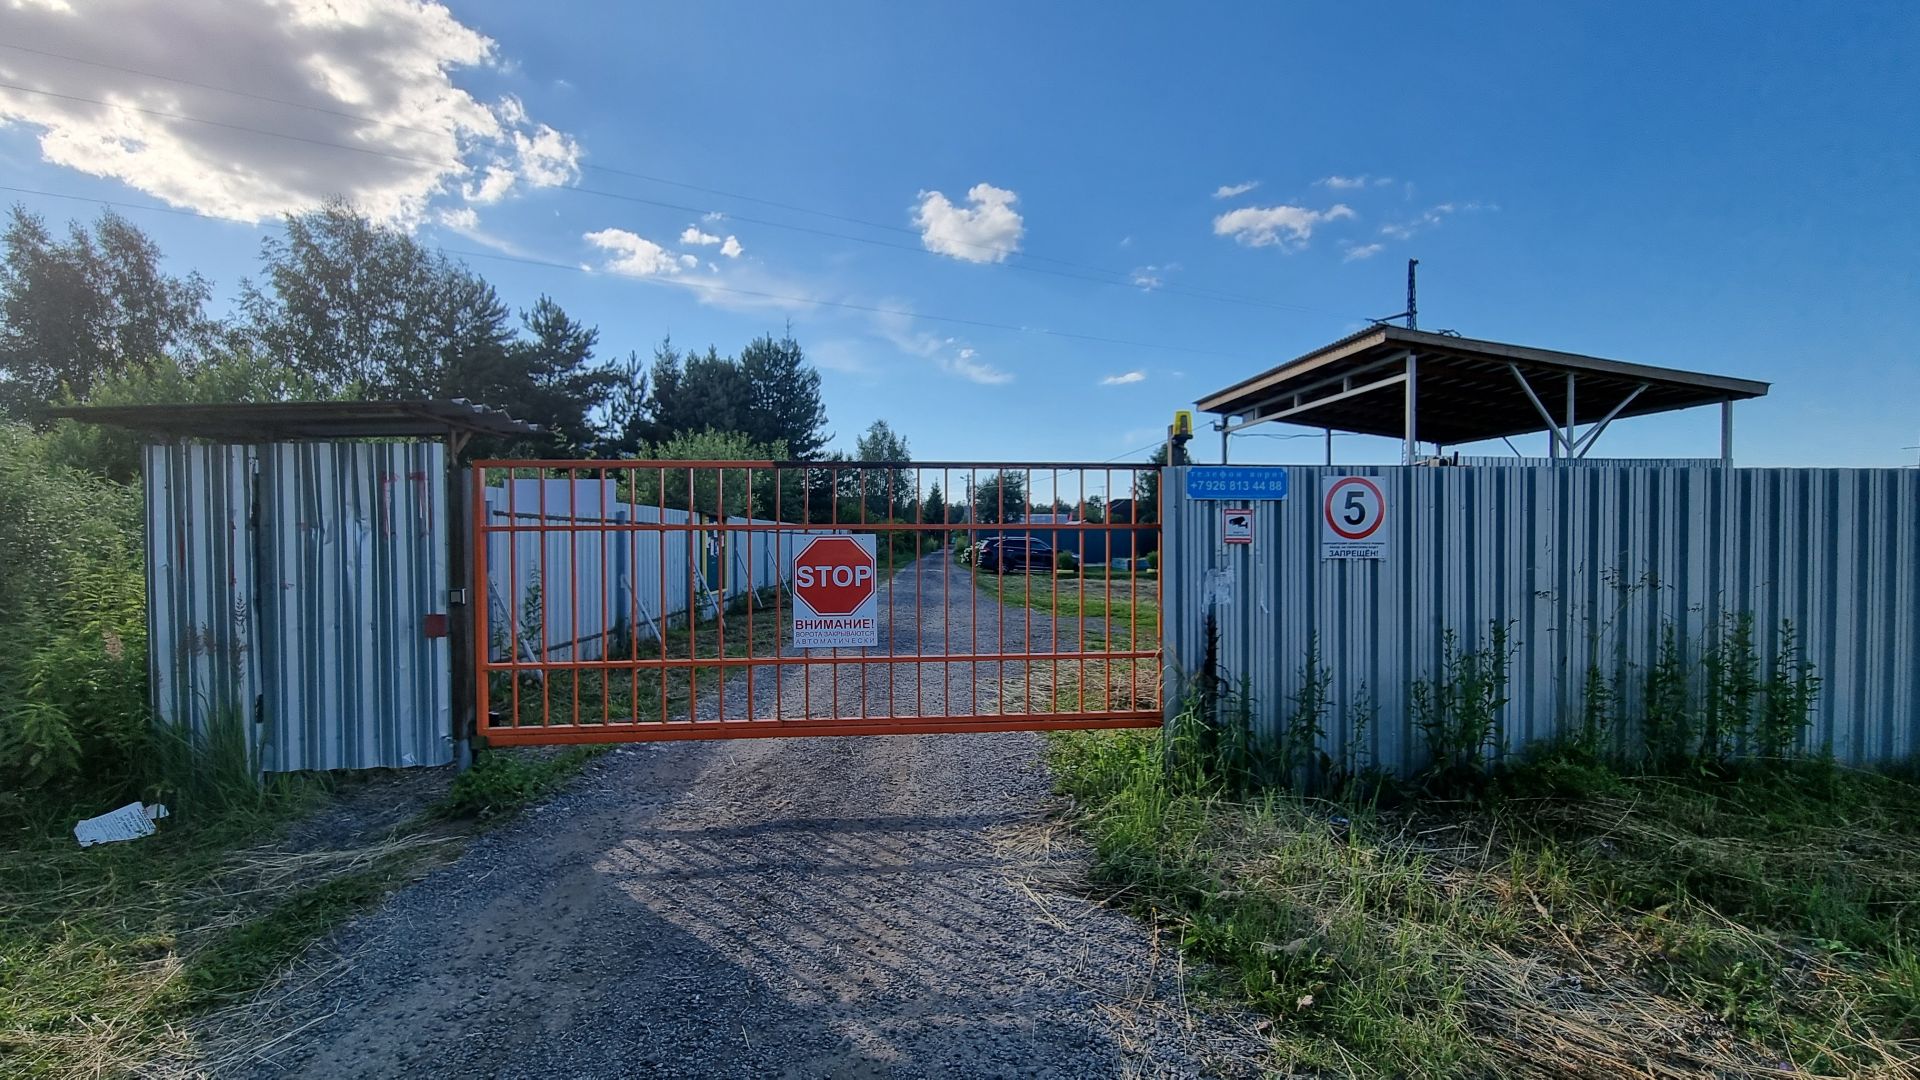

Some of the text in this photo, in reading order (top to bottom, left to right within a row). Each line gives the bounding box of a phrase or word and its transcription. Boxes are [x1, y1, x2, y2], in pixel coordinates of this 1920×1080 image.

[1191, 481, 1282, 490] +7 926 813 44 88
[1344, 491, 1366, 525] 5
[797, 565, 871, 587] STOP
[795, 619, 874, 629] ВНИМАНИЕ!
